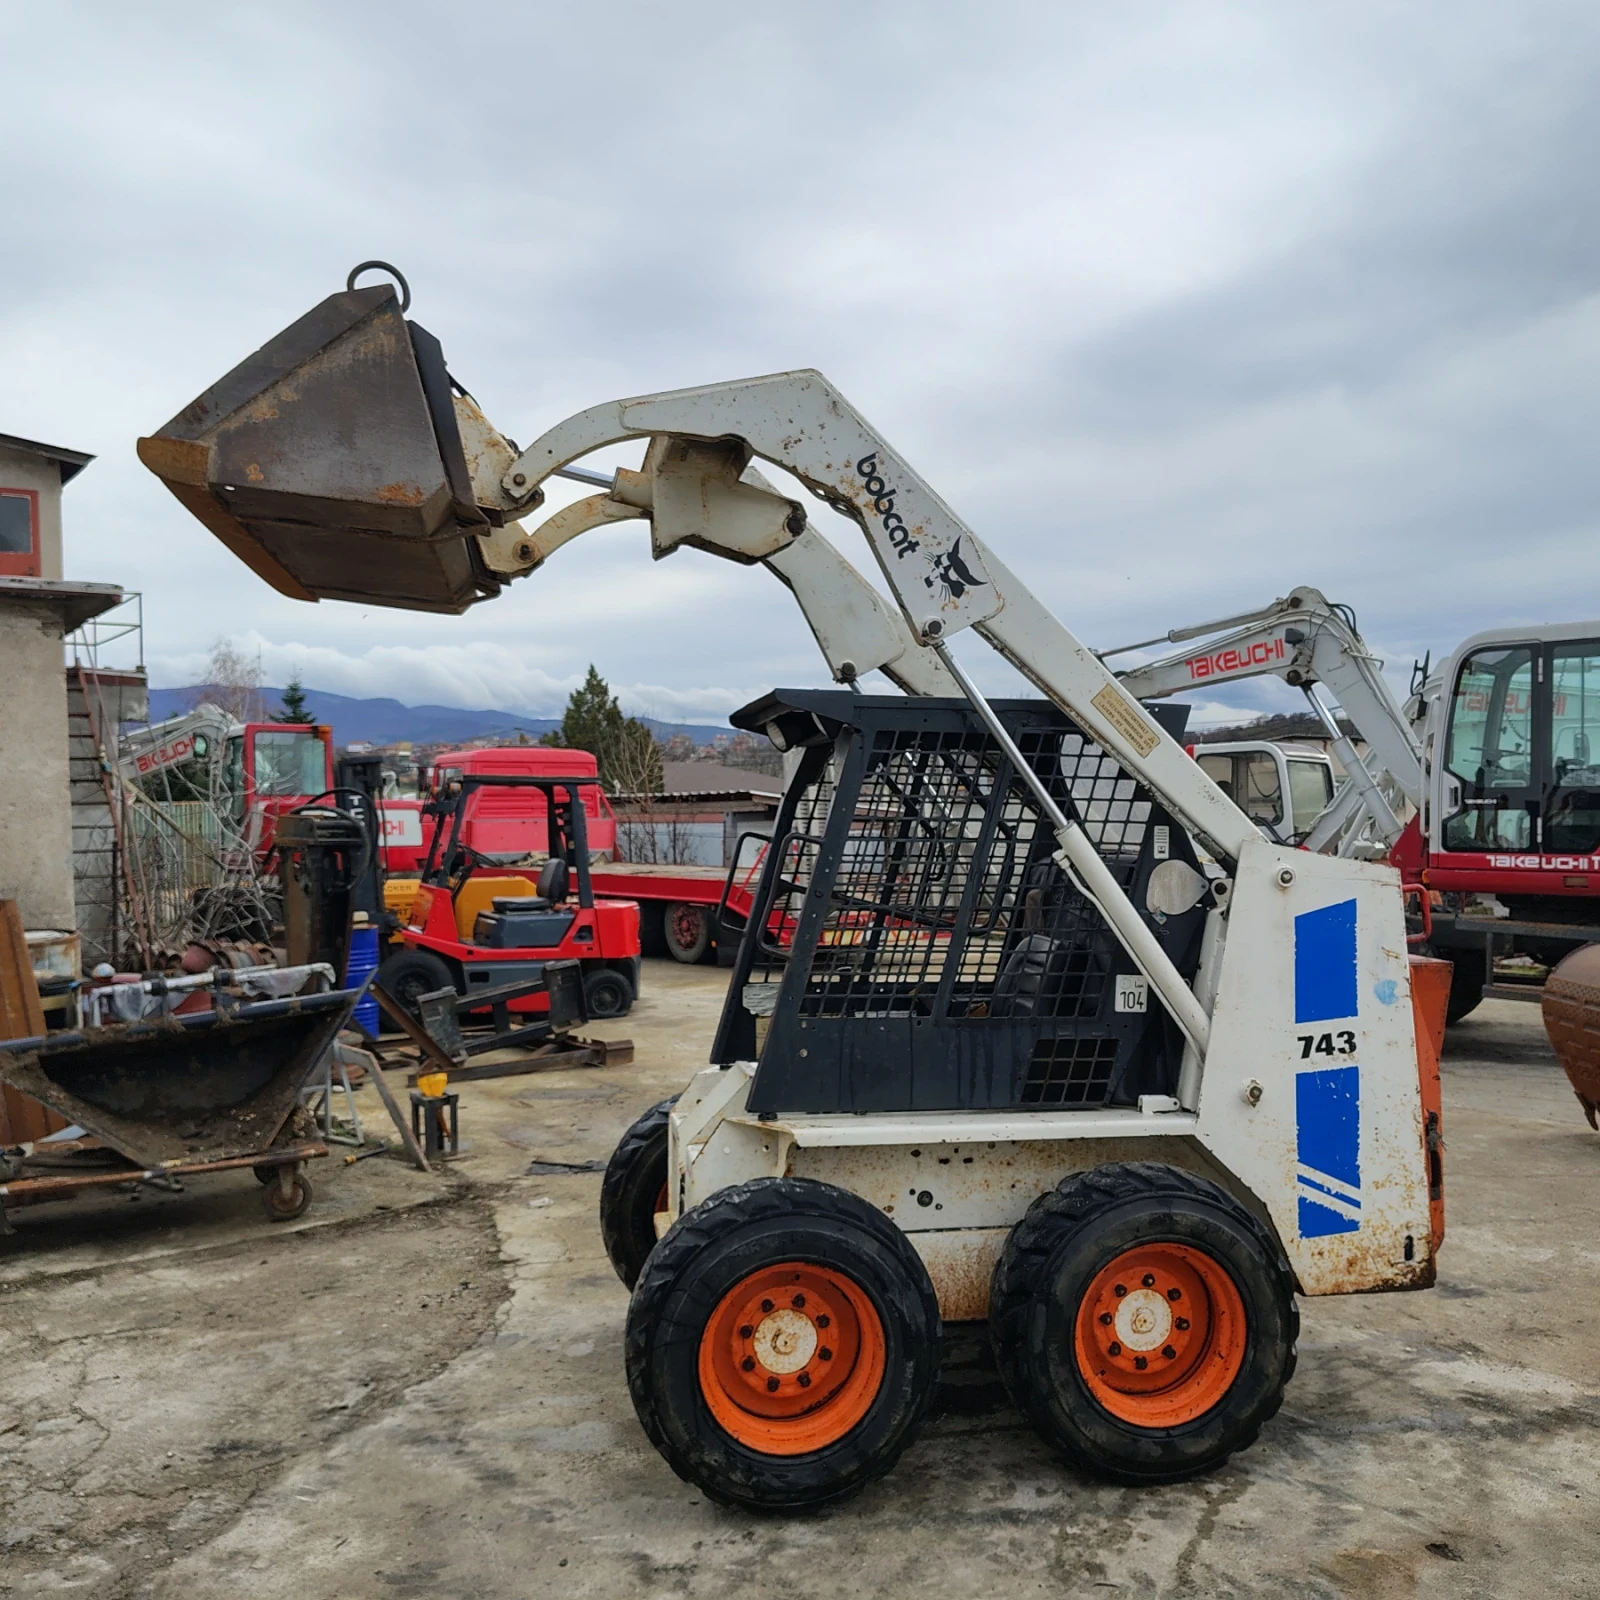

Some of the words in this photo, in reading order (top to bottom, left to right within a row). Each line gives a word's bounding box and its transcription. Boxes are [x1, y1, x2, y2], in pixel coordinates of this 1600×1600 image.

[857, 451, 920, 559] bobcat
[1119, 991, 1144, 1010] 104
[1297, 1030, 1357, 1059] 743
